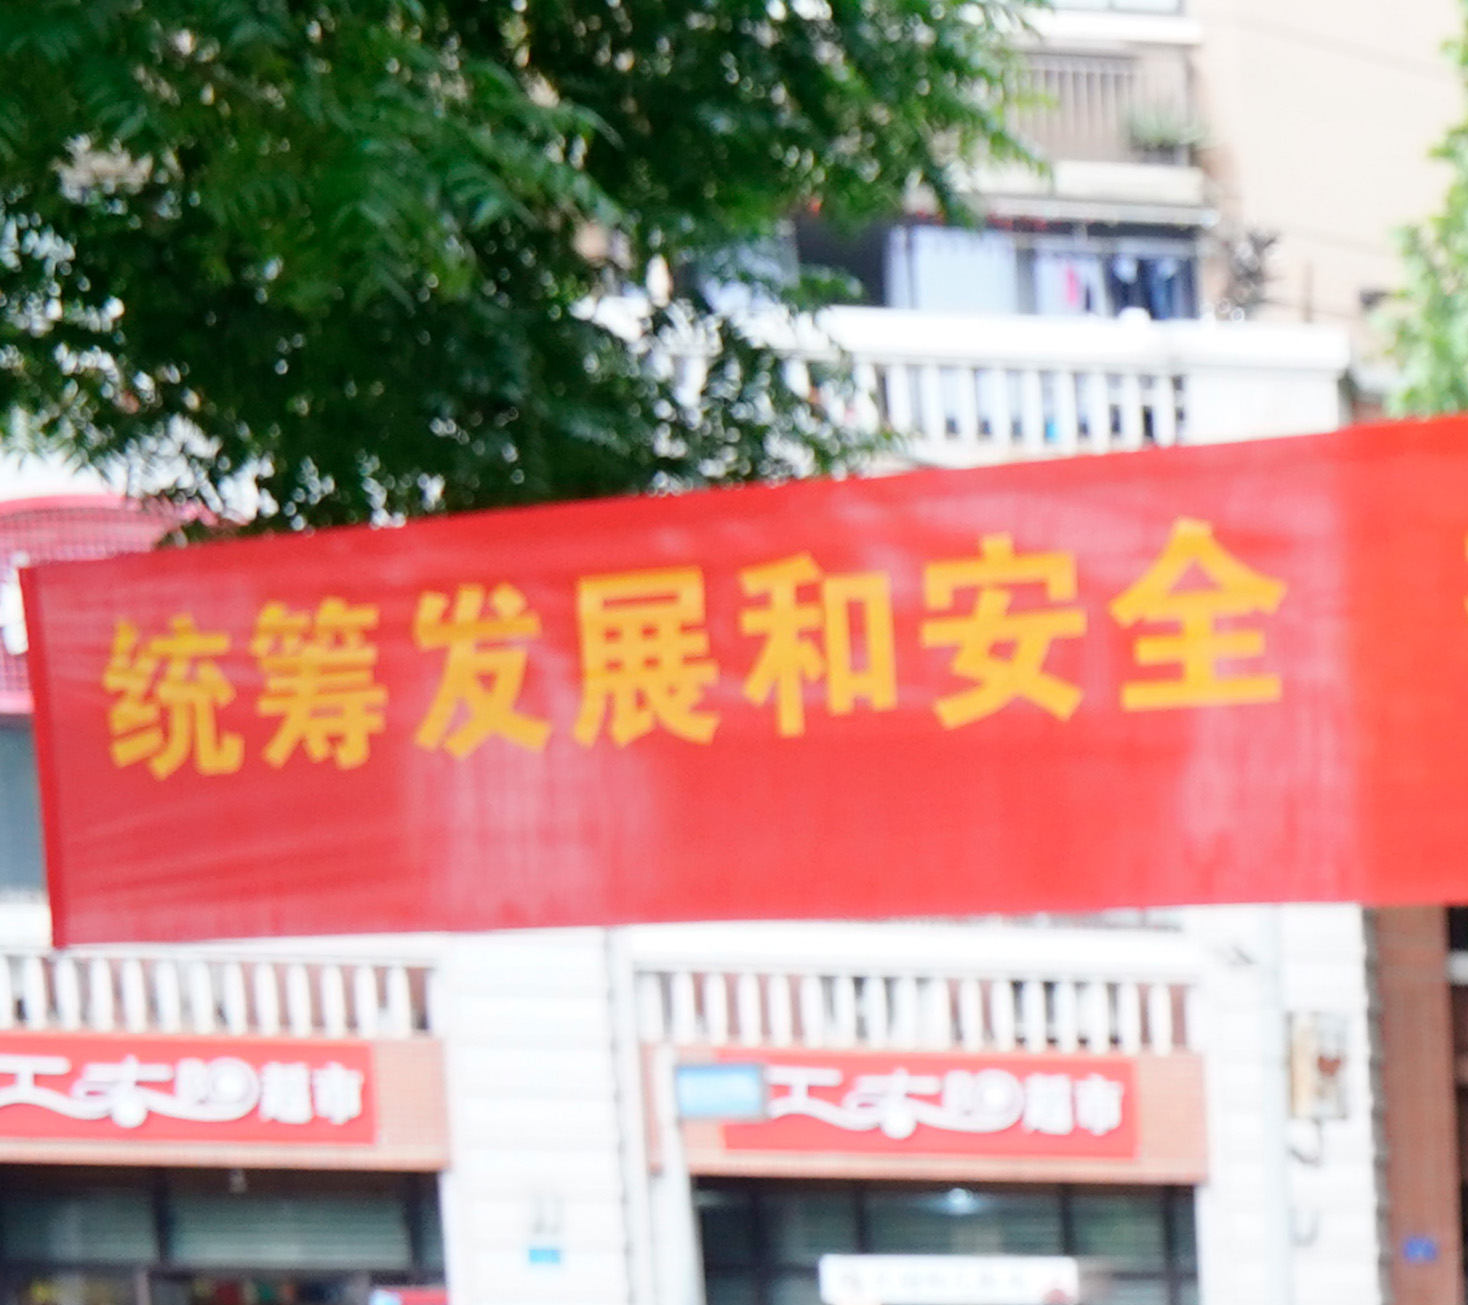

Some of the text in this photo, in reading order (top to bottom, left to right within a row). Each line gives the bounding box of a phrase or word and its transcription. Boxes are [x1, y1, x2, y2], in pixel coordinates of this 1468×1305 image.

[104, 518, 1288, 780] 统筹发展和安全
